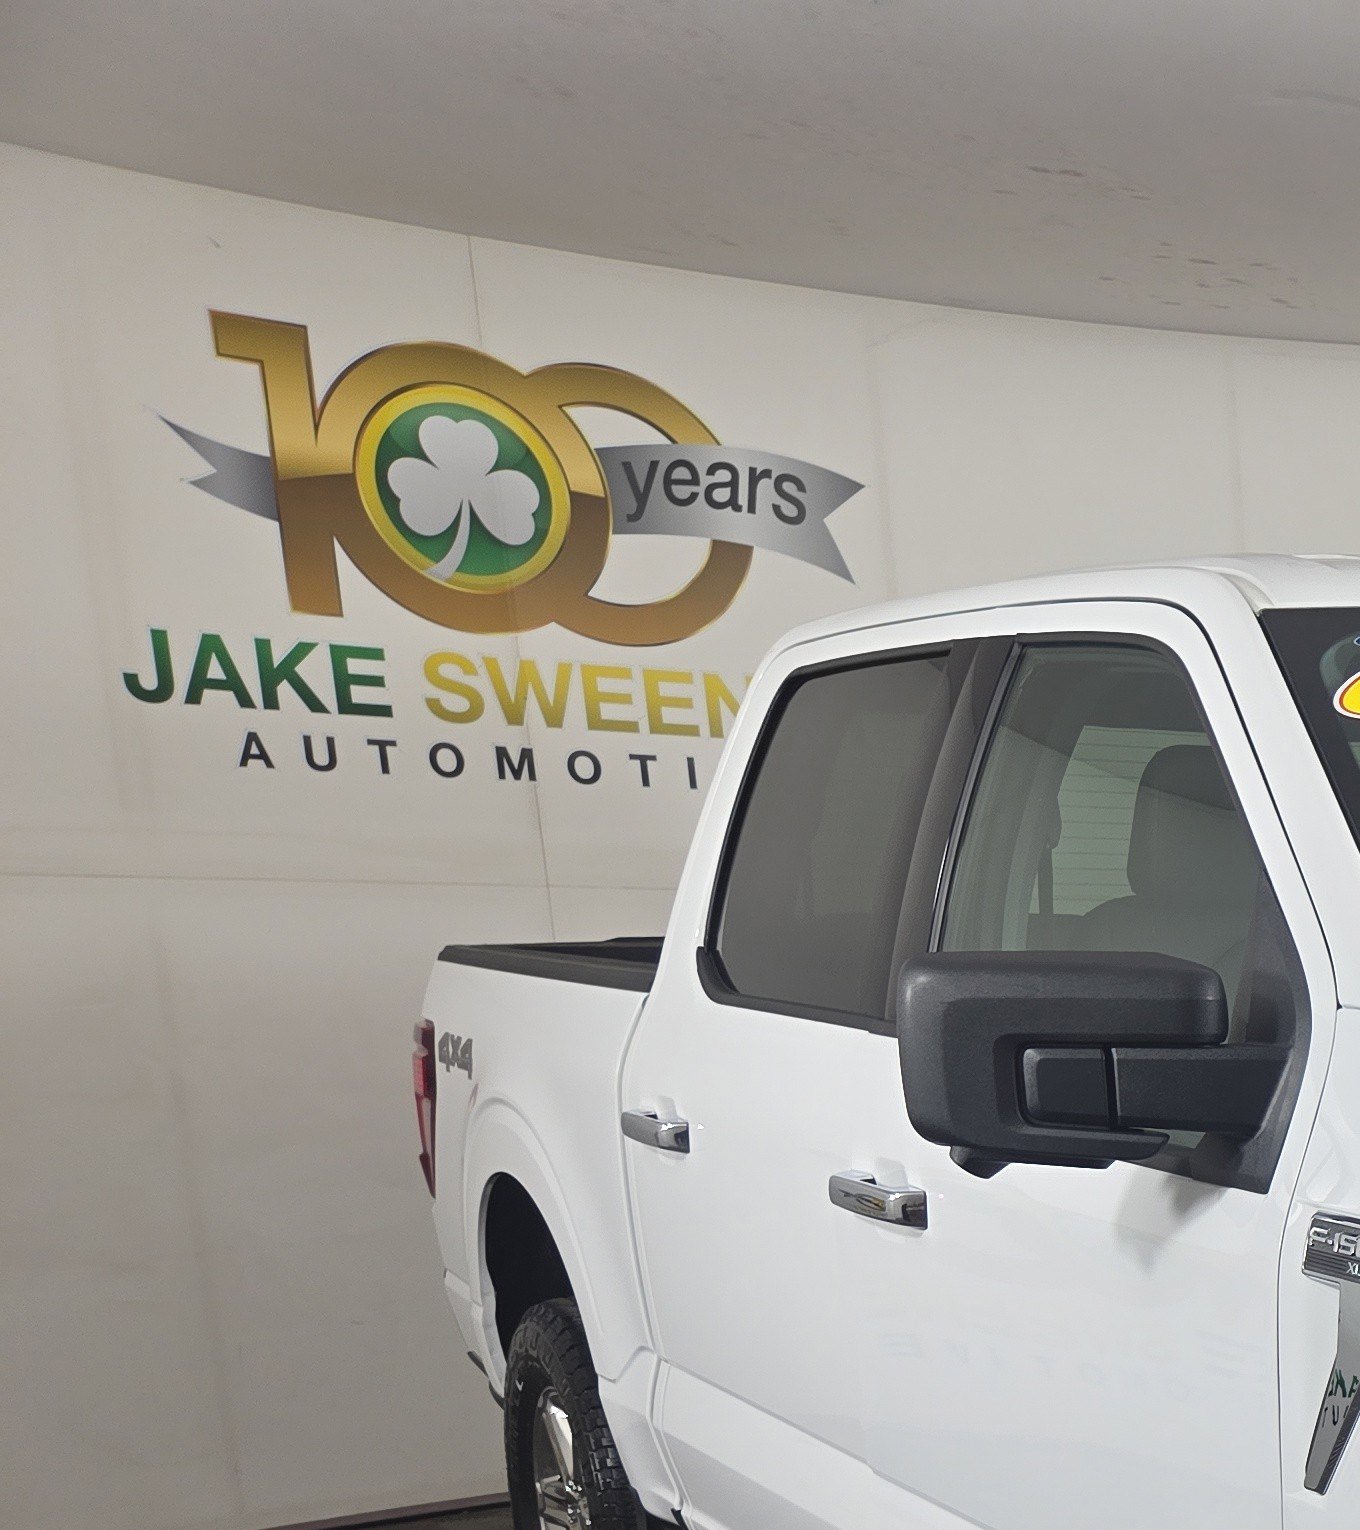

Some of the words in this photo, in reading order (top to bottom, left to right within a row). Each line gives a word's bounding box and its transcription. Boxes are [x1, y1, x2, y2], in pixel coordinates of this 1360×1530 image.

[621, 456, 809, 526] years
[122, 627, 394, 719] JAKE
[422, 652, 755, 740] SWEEN
[238, 730, 699, 790] AUTOMOTI
